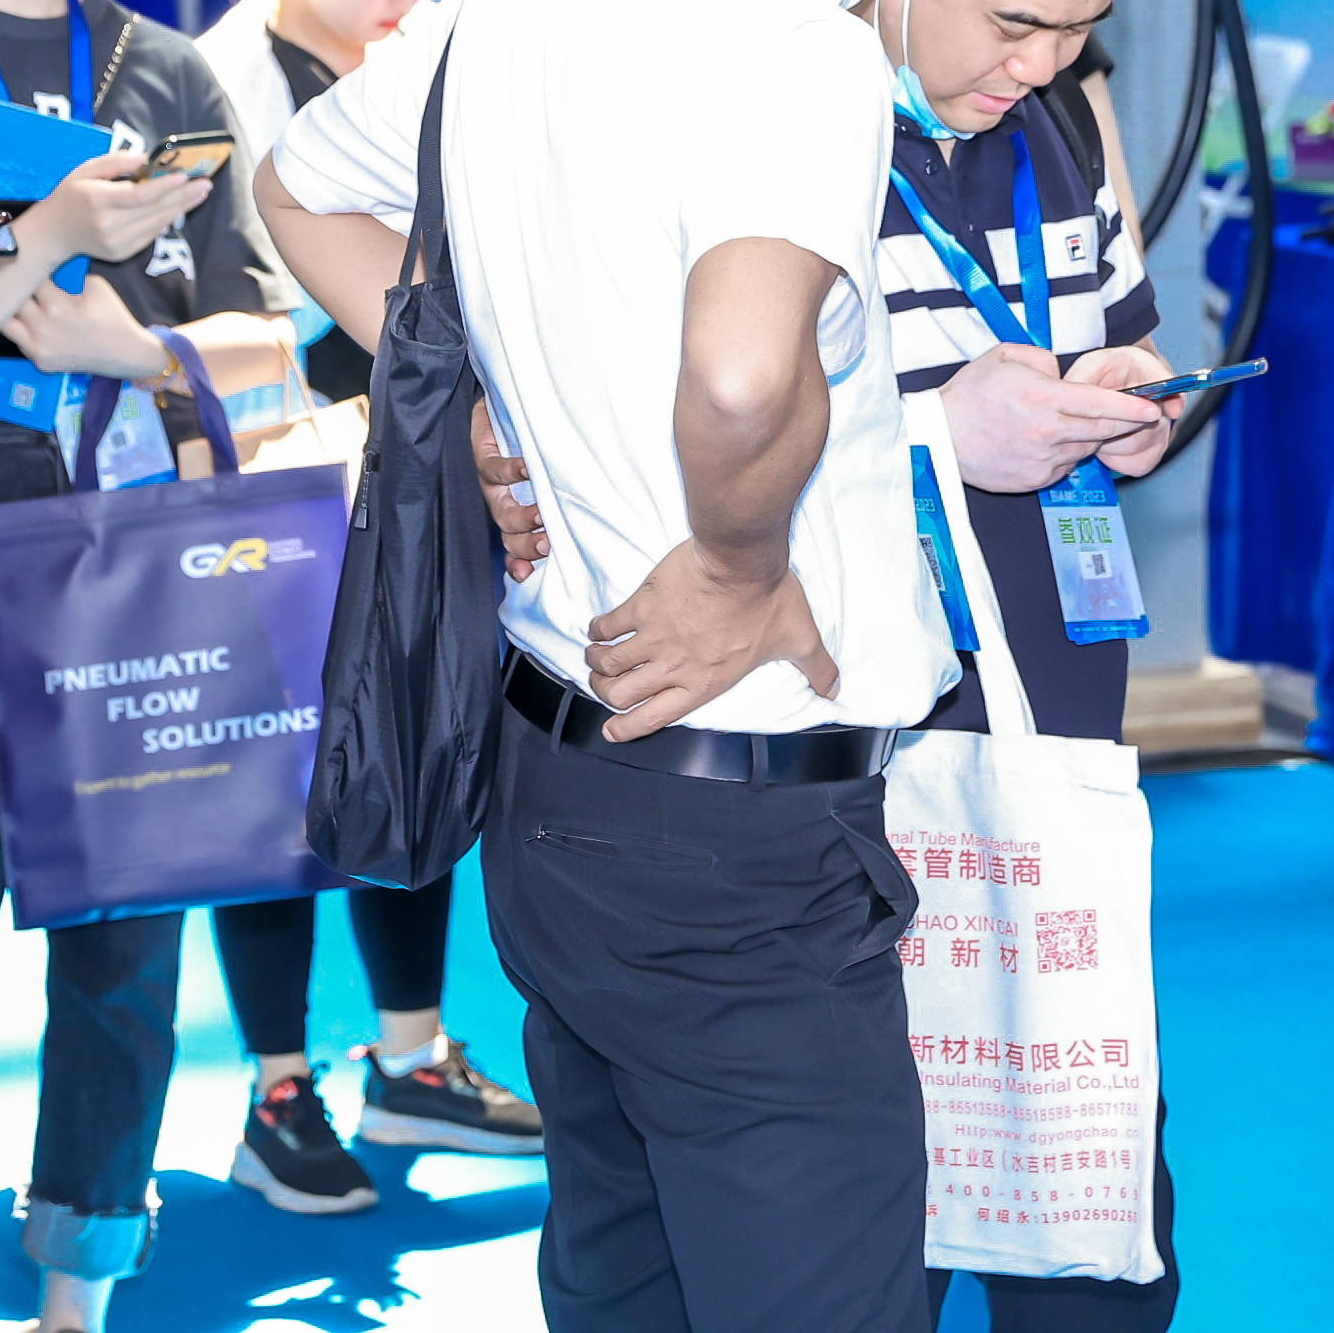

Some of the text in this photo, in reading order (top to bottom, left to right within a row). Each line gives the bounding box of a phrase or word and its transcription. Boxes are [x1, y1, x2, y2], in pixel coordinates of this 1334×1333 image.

[44, 646, 231, 694] PNEUMATIC
[107, 686, 202, 722] FLOW
[142, 706, 319, 753] SOLUTIONS
[918, 830, 957, 846] Tube
[908, 1034, 1130, 1074] 新材料有限公司
[920, 1071, 1001, 1093] Insulating
[1005, 1076, 1071, 1095] Material
